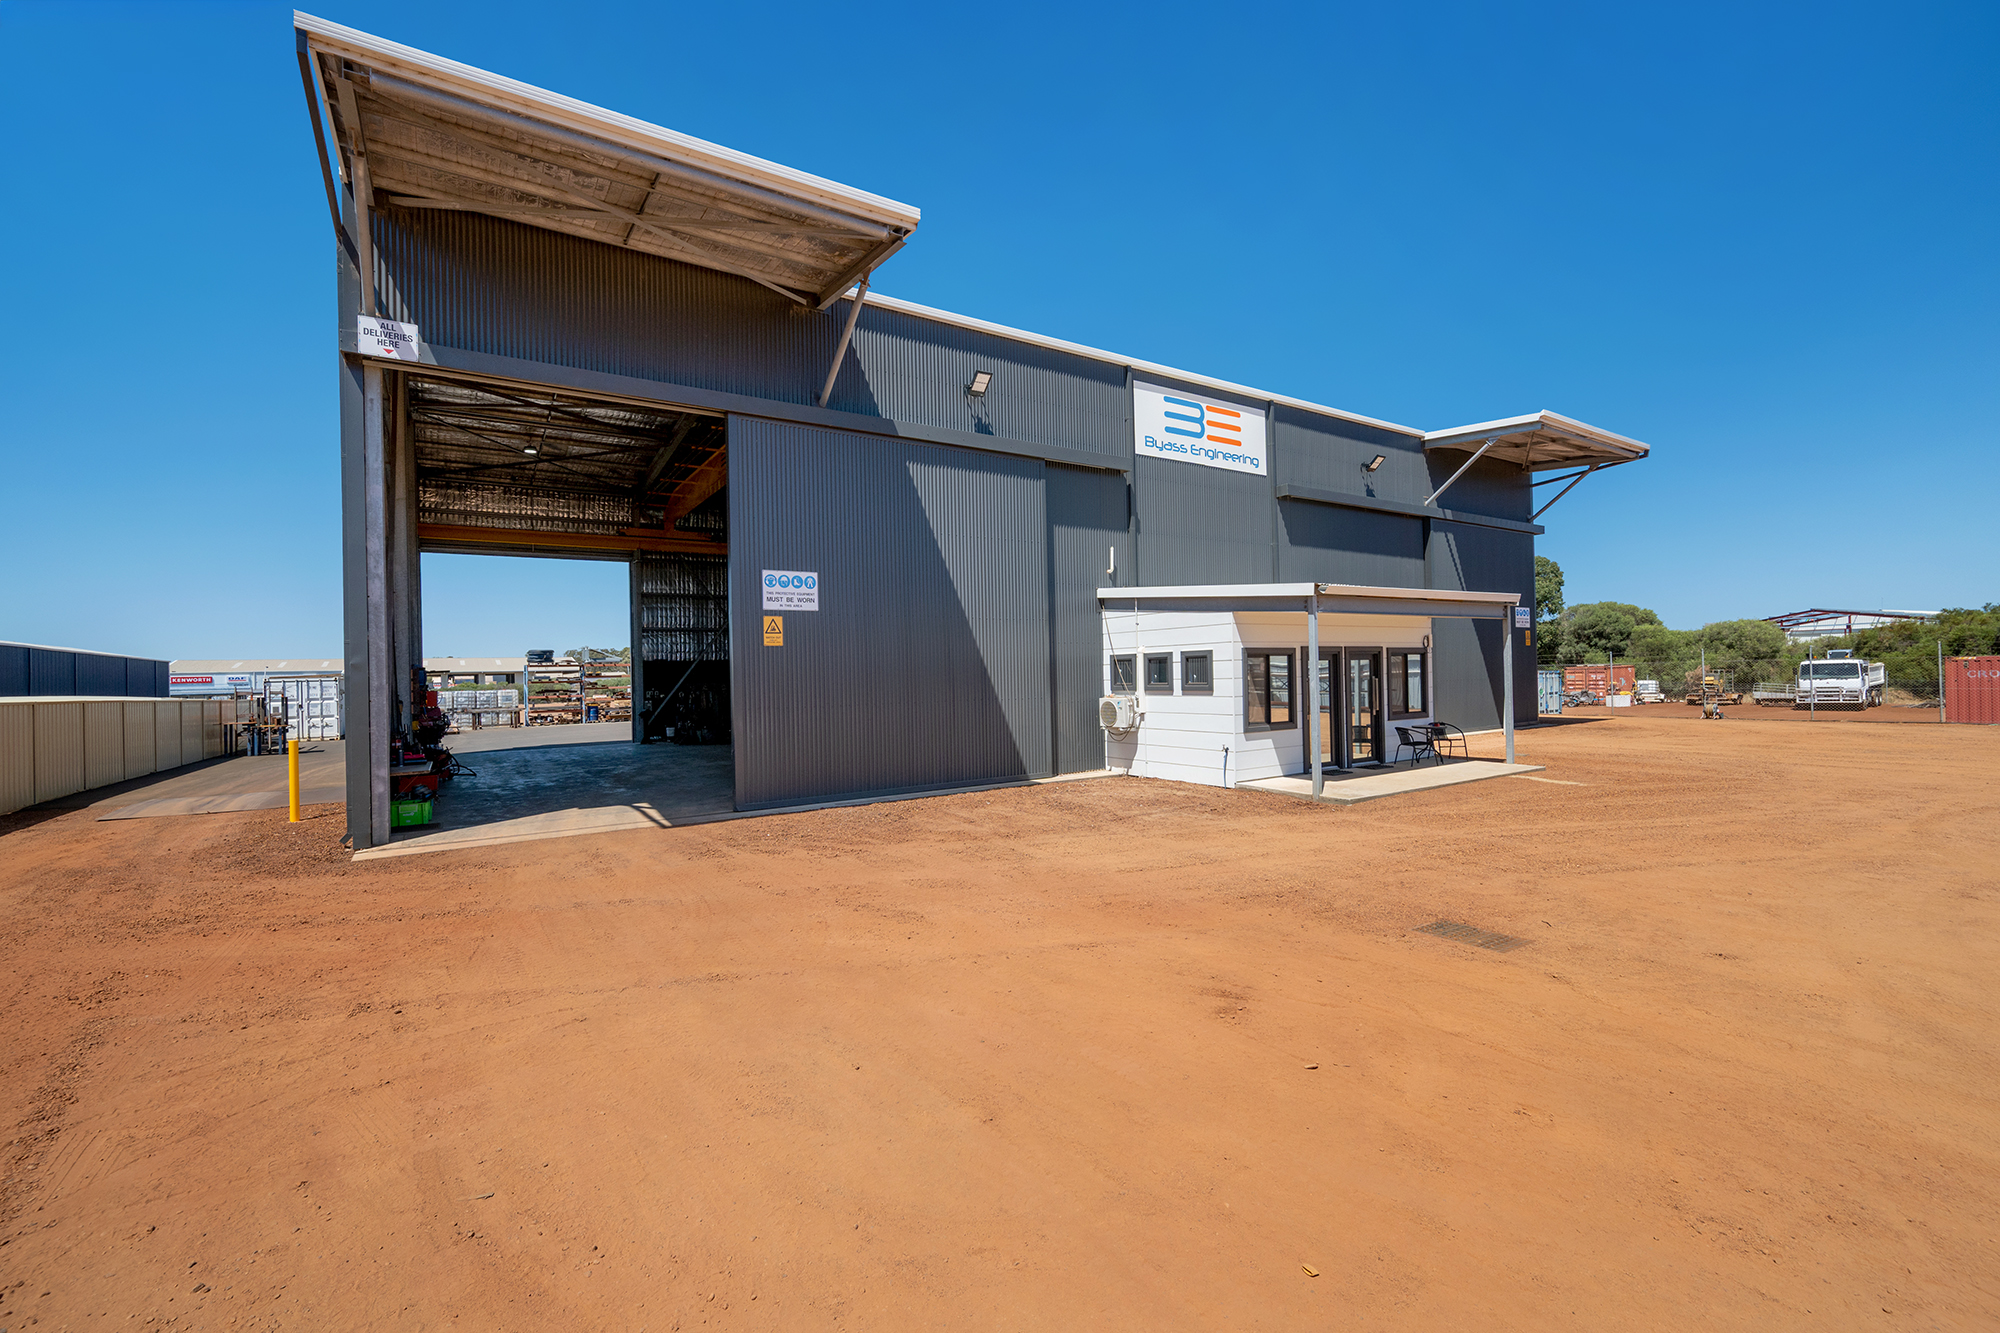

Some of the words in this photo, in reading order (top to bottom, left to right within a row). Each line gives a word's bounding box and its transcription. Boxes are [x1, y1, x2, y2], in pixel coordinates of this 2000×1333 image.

[380, 322, 396, 331] ALL
[363, 327, 413, 342] DELIVERIES
[377, 338, 400, 348] HERE
[1163, 395, 1242, 447] BE
[1144, 435, 1188, 453] Byass
[1190, 444, 1260, 468] Engineering
